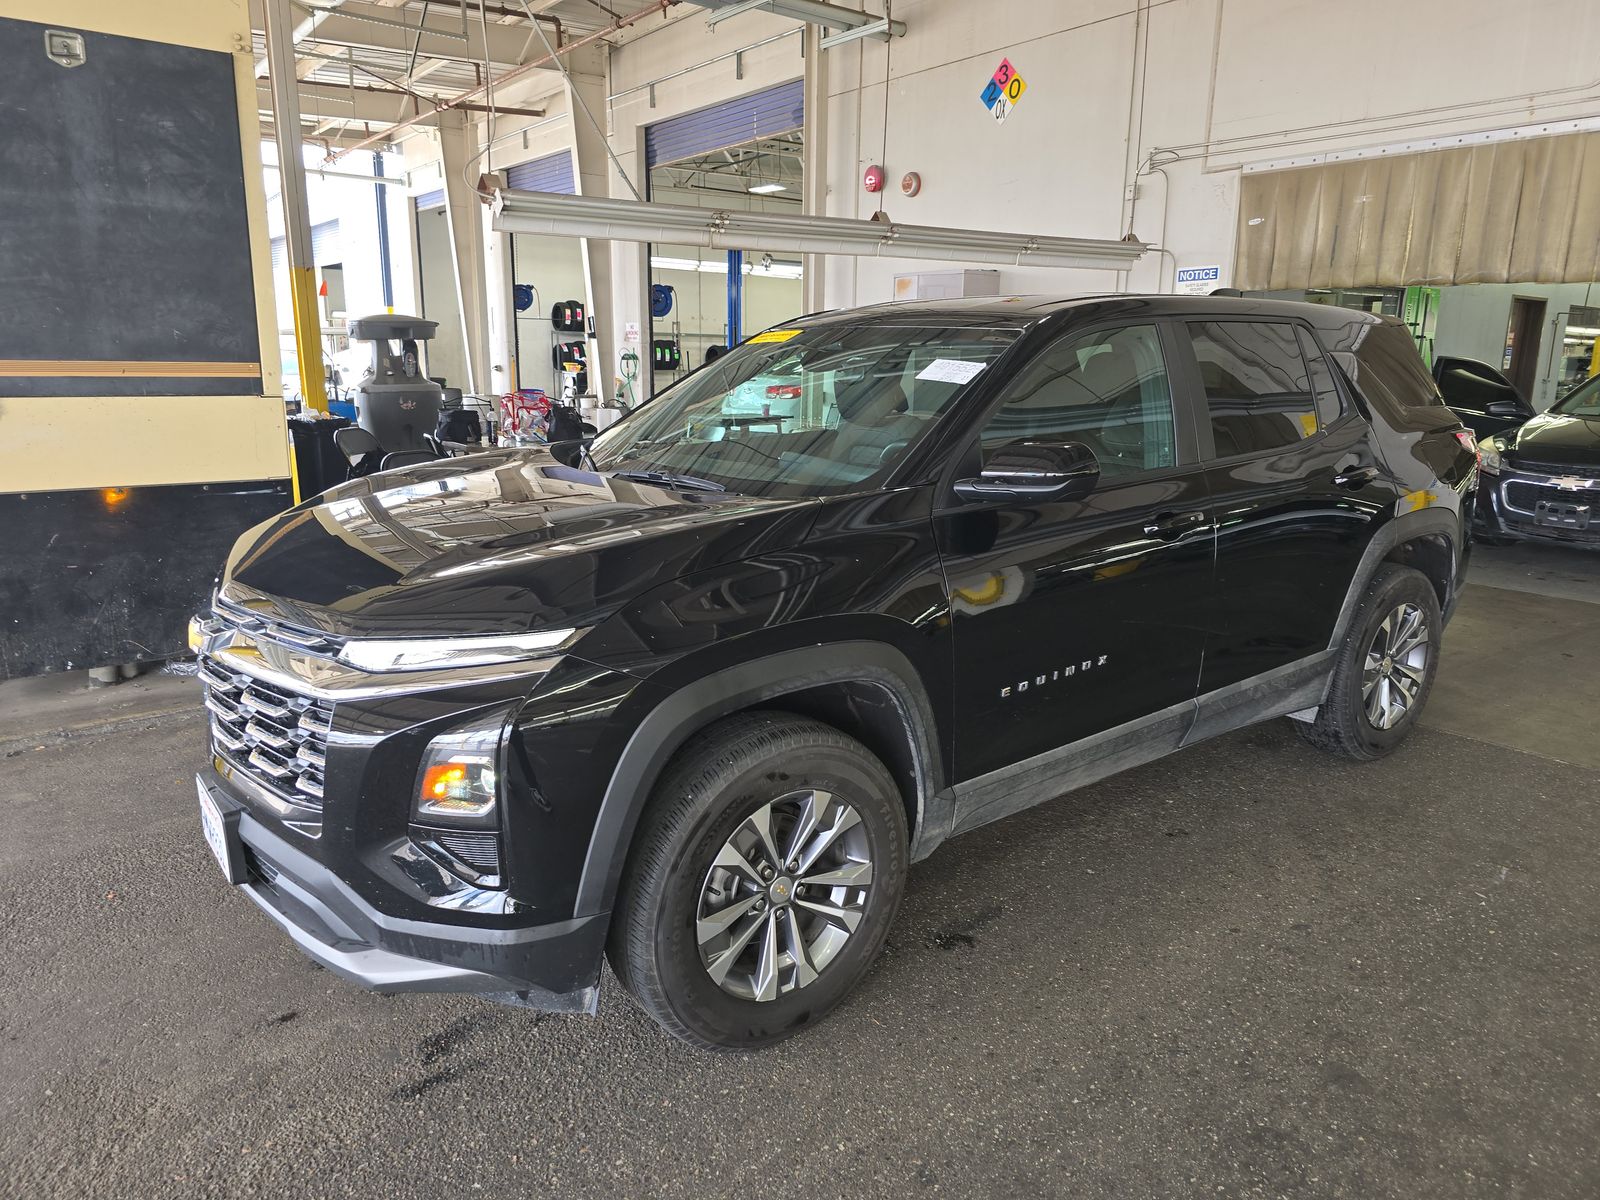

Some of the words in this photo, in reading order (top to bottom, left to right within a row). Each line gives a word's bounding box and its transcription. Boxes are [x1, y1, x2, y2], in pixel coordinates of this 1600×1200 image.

[998, 64, 1009, 85] 3
[987, 82, 997, 103] 2
[1009, 78, 1021, 99] 0
[995, 99, 1008, 120] OX
[1180, 269, 1217, 281] NOTICE
[1001, 655, 1107, 698] EQUINOX
